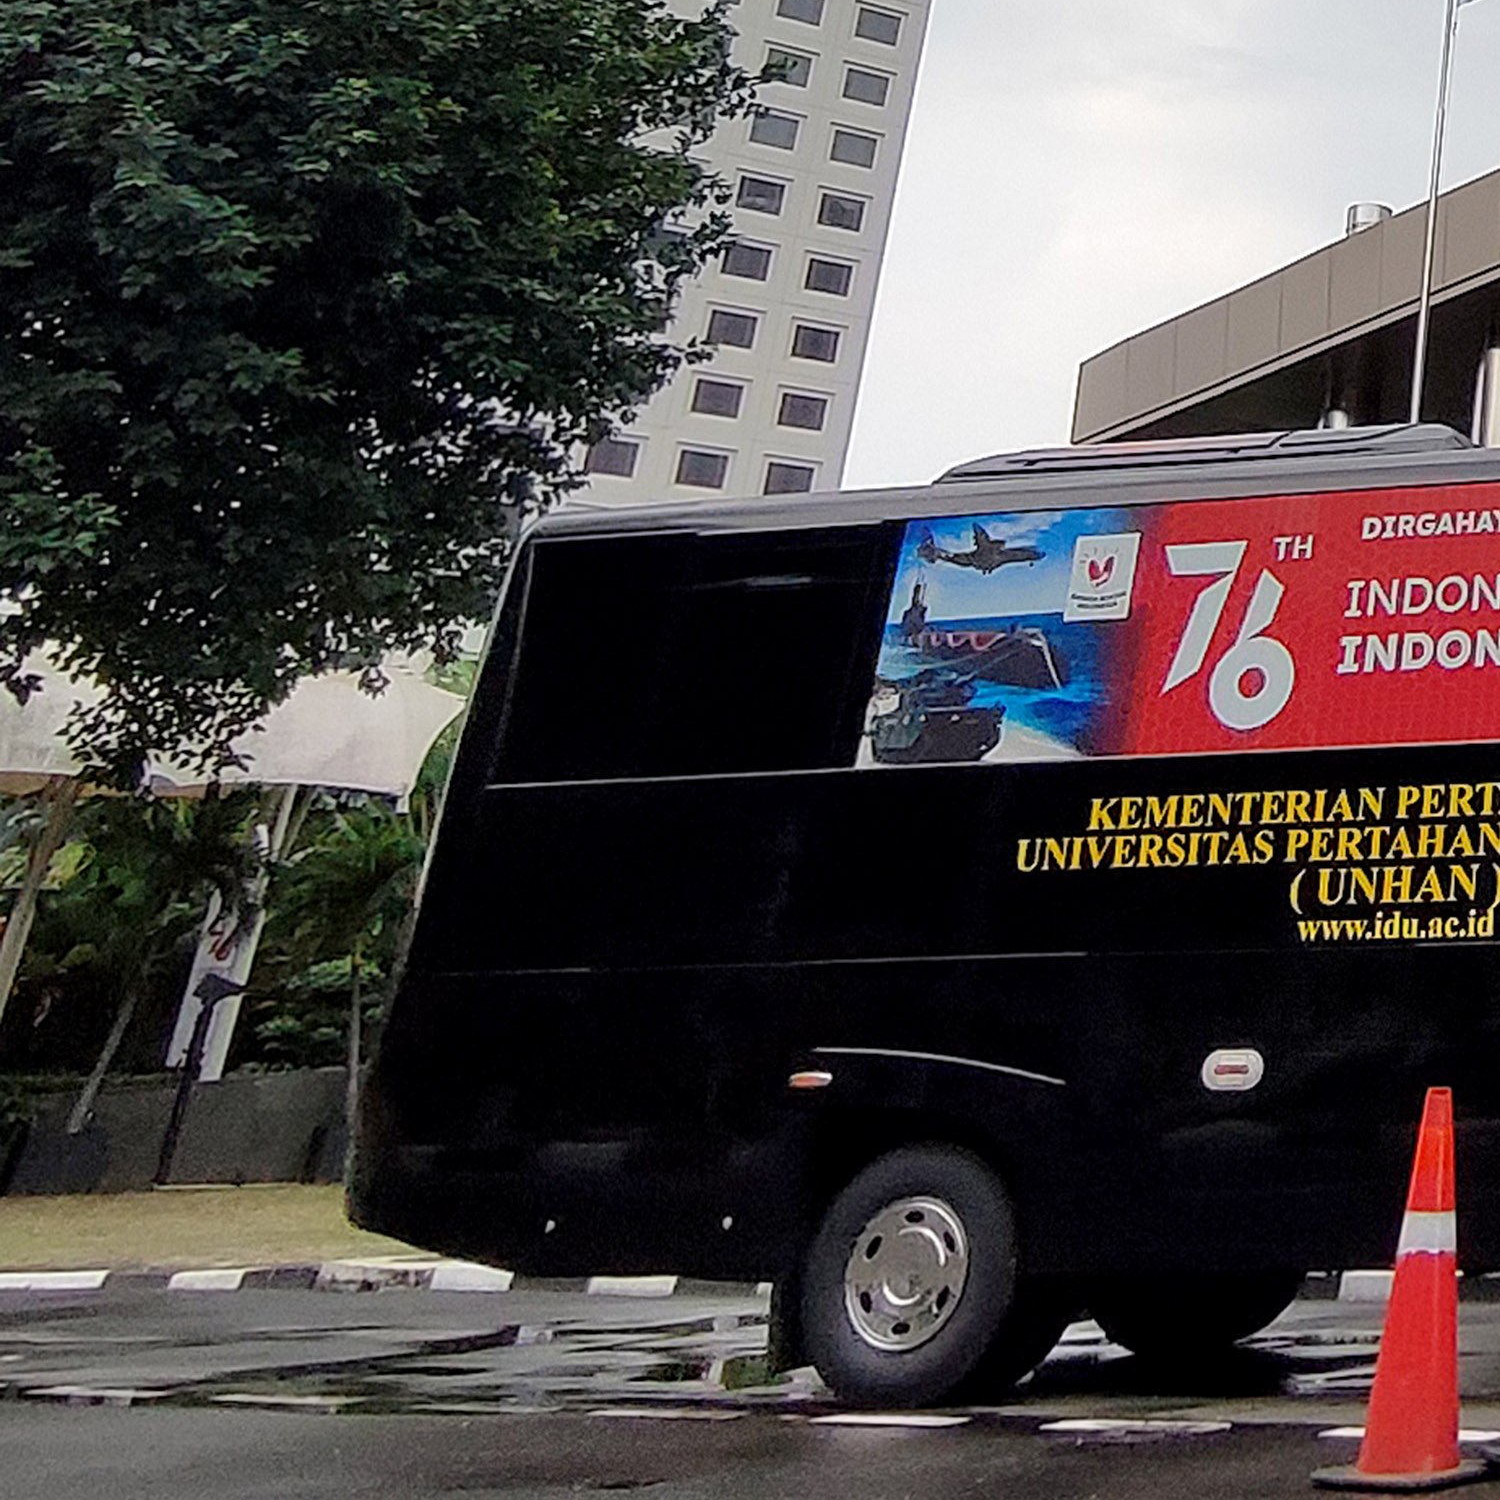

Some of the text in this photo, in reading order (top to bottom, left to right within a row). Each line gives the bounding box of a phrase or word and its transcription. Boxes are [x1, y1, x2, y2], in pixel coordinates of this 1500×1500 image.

[1086, 786, 1387, 832] KEMENTERIAN
[1017, 829, 1275, 872] UNIVERSITAS
[1297, 908, 1495, 942] www.idu.ac.id
